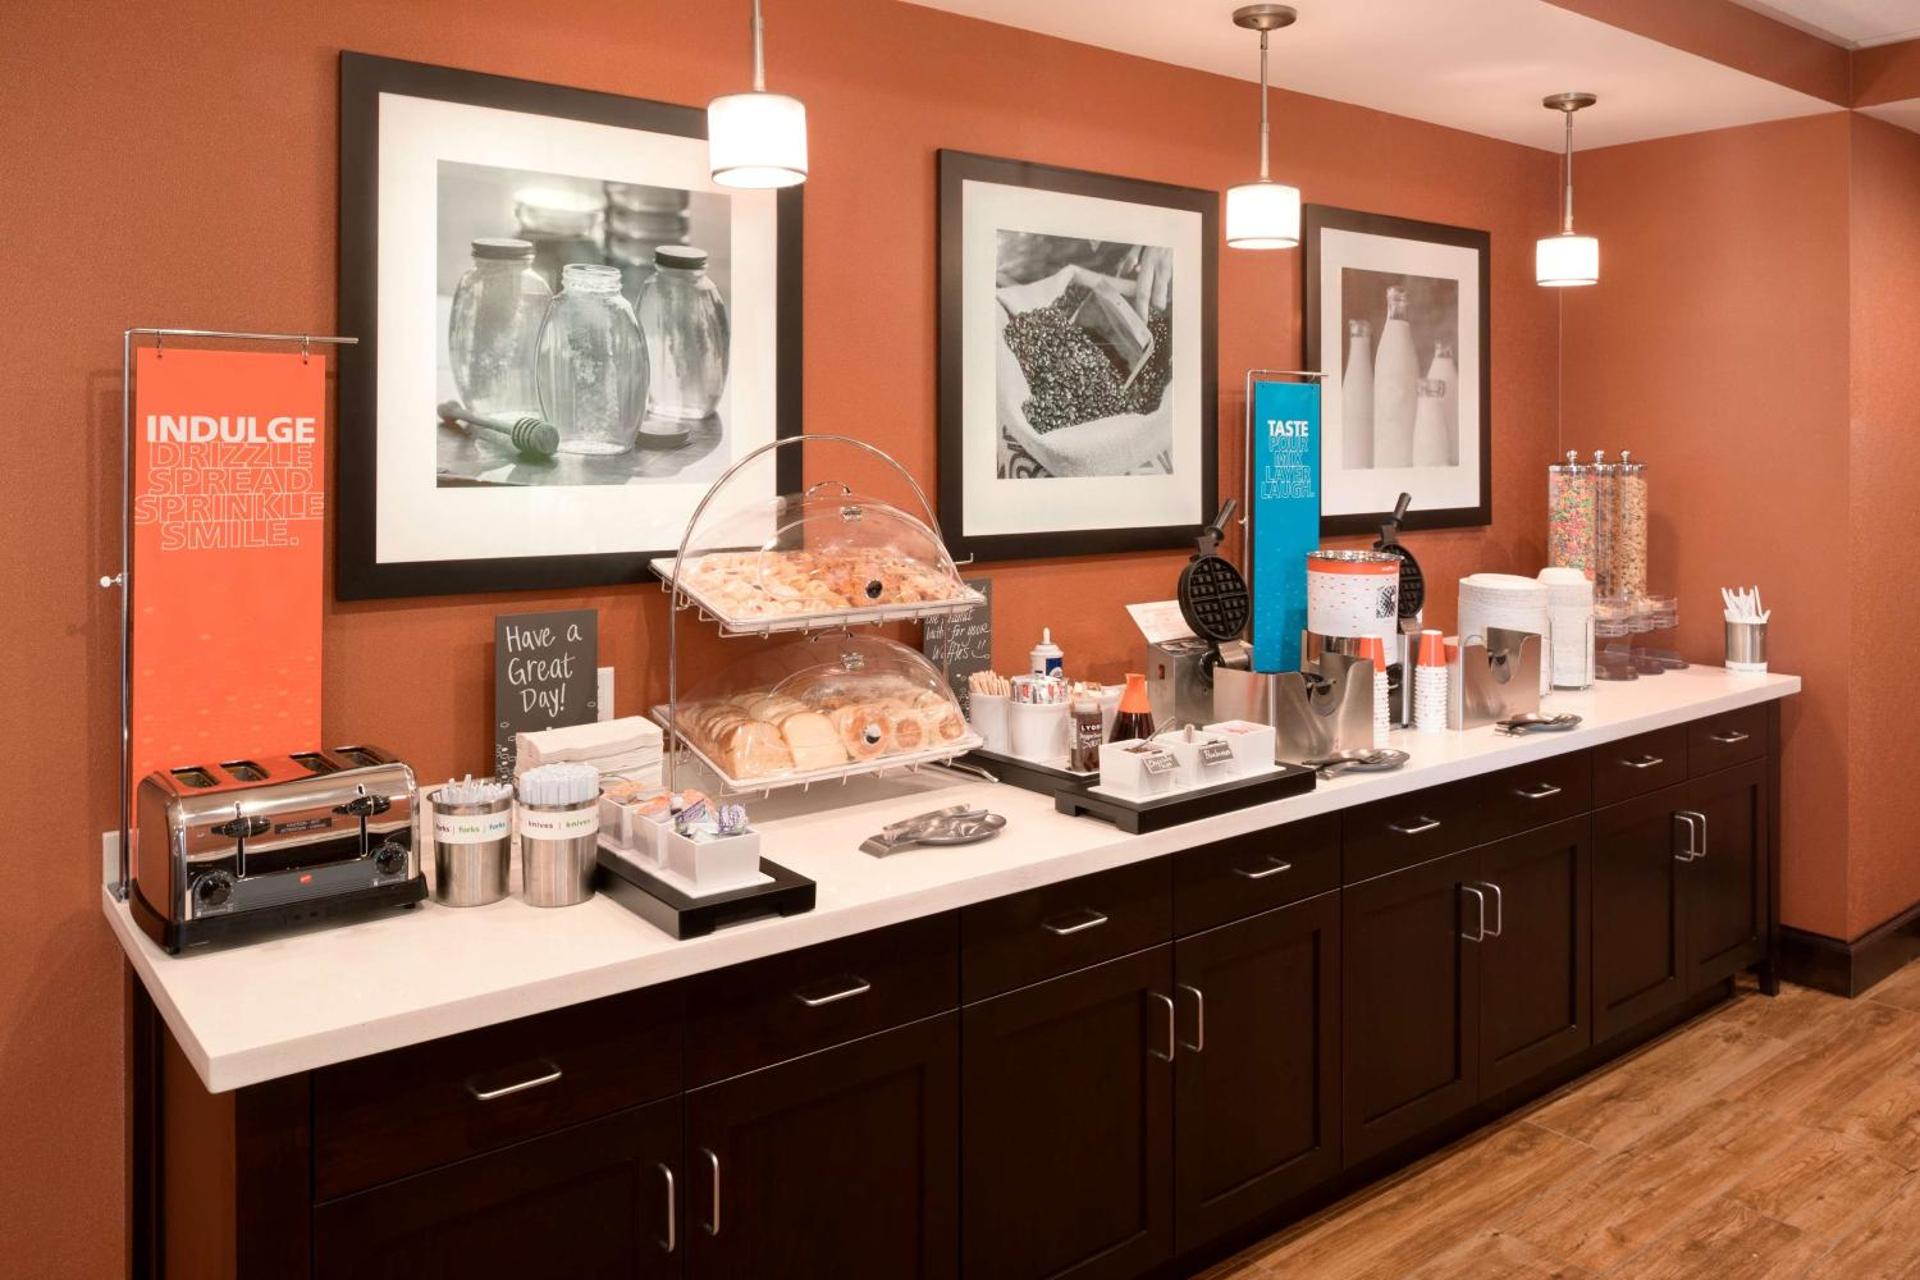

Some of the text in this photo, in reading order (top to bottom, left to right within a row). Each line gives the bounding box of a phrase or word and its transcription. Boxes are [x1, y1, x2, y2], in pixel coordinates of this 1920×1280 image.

[146, 415, 315, 443] INDULGE
[1267, 420, 1309, 437] TASTE
[150, 441, 312, 468] DRIZZLE
[148, 467, 313, 495] SPREAD
[135, 492, 324, 525] SPRINKLE
[161, 519, 299, 551] SMILE.
[505, 624, 583, 652] Have a
[508, 653, 576, 686] Great
[521, 683, 566, 718] Day!
